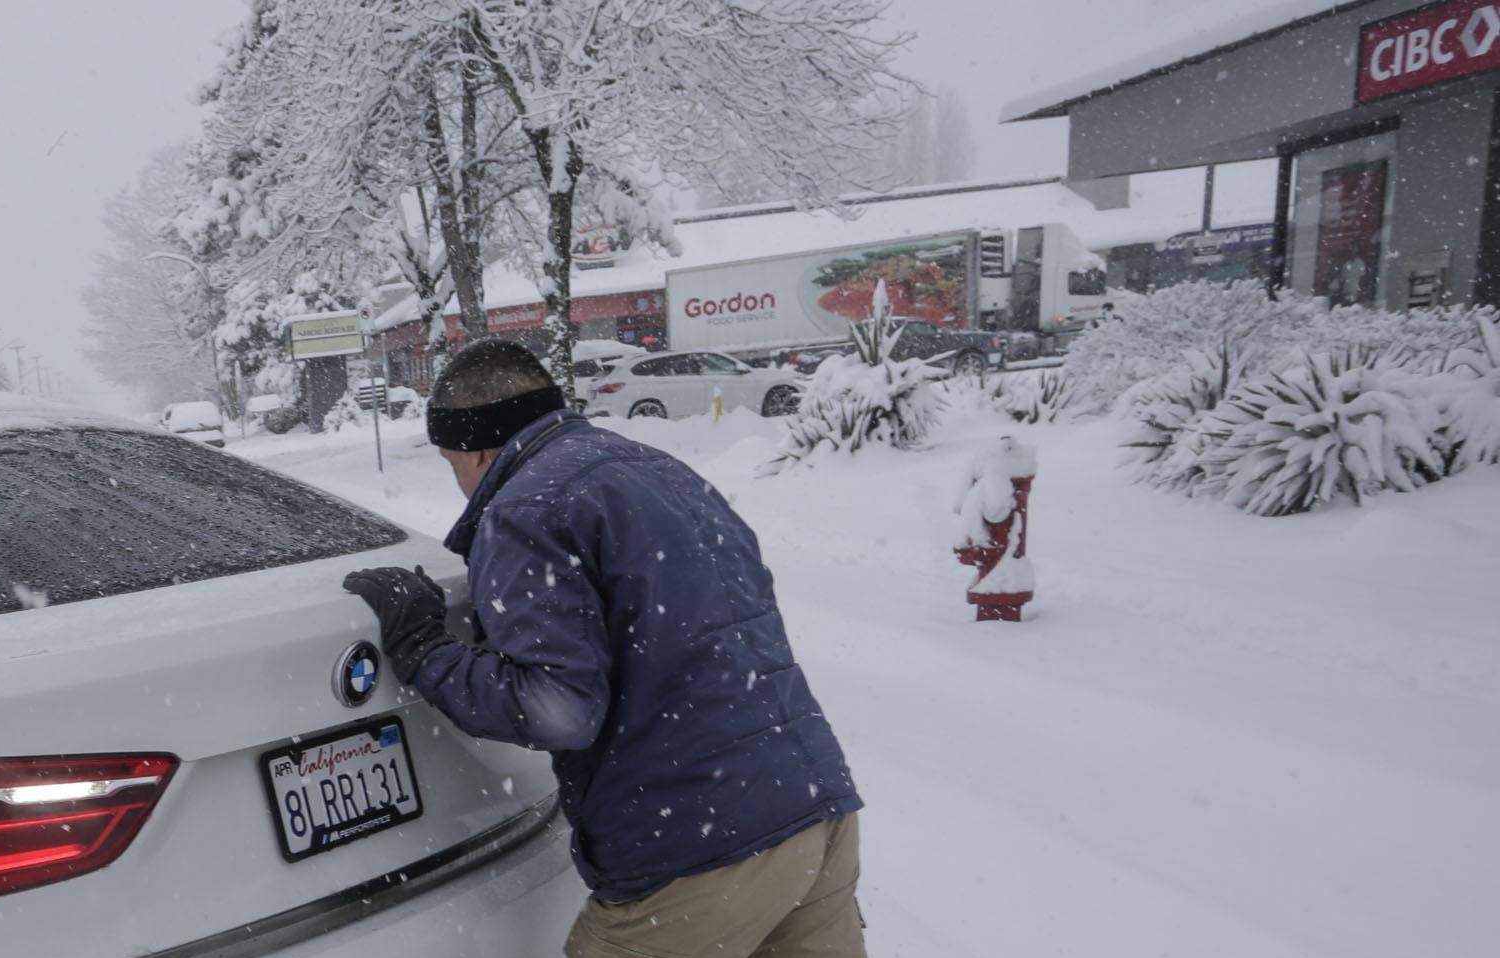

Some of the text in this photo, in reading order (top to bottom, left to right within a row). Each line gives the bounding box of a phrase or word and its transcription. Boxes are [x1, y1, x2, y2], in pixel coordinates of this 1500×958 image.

[1369, 18, 1458, 82] CIBC
[684, 292, 776, 318] Gordon
[707, 311, 777, 326] FOOD SERVICE
[274, 761, 293, 778] APR
[297, 738, 383, 777] California
[285, 758, 410, 838] 8LRR131
